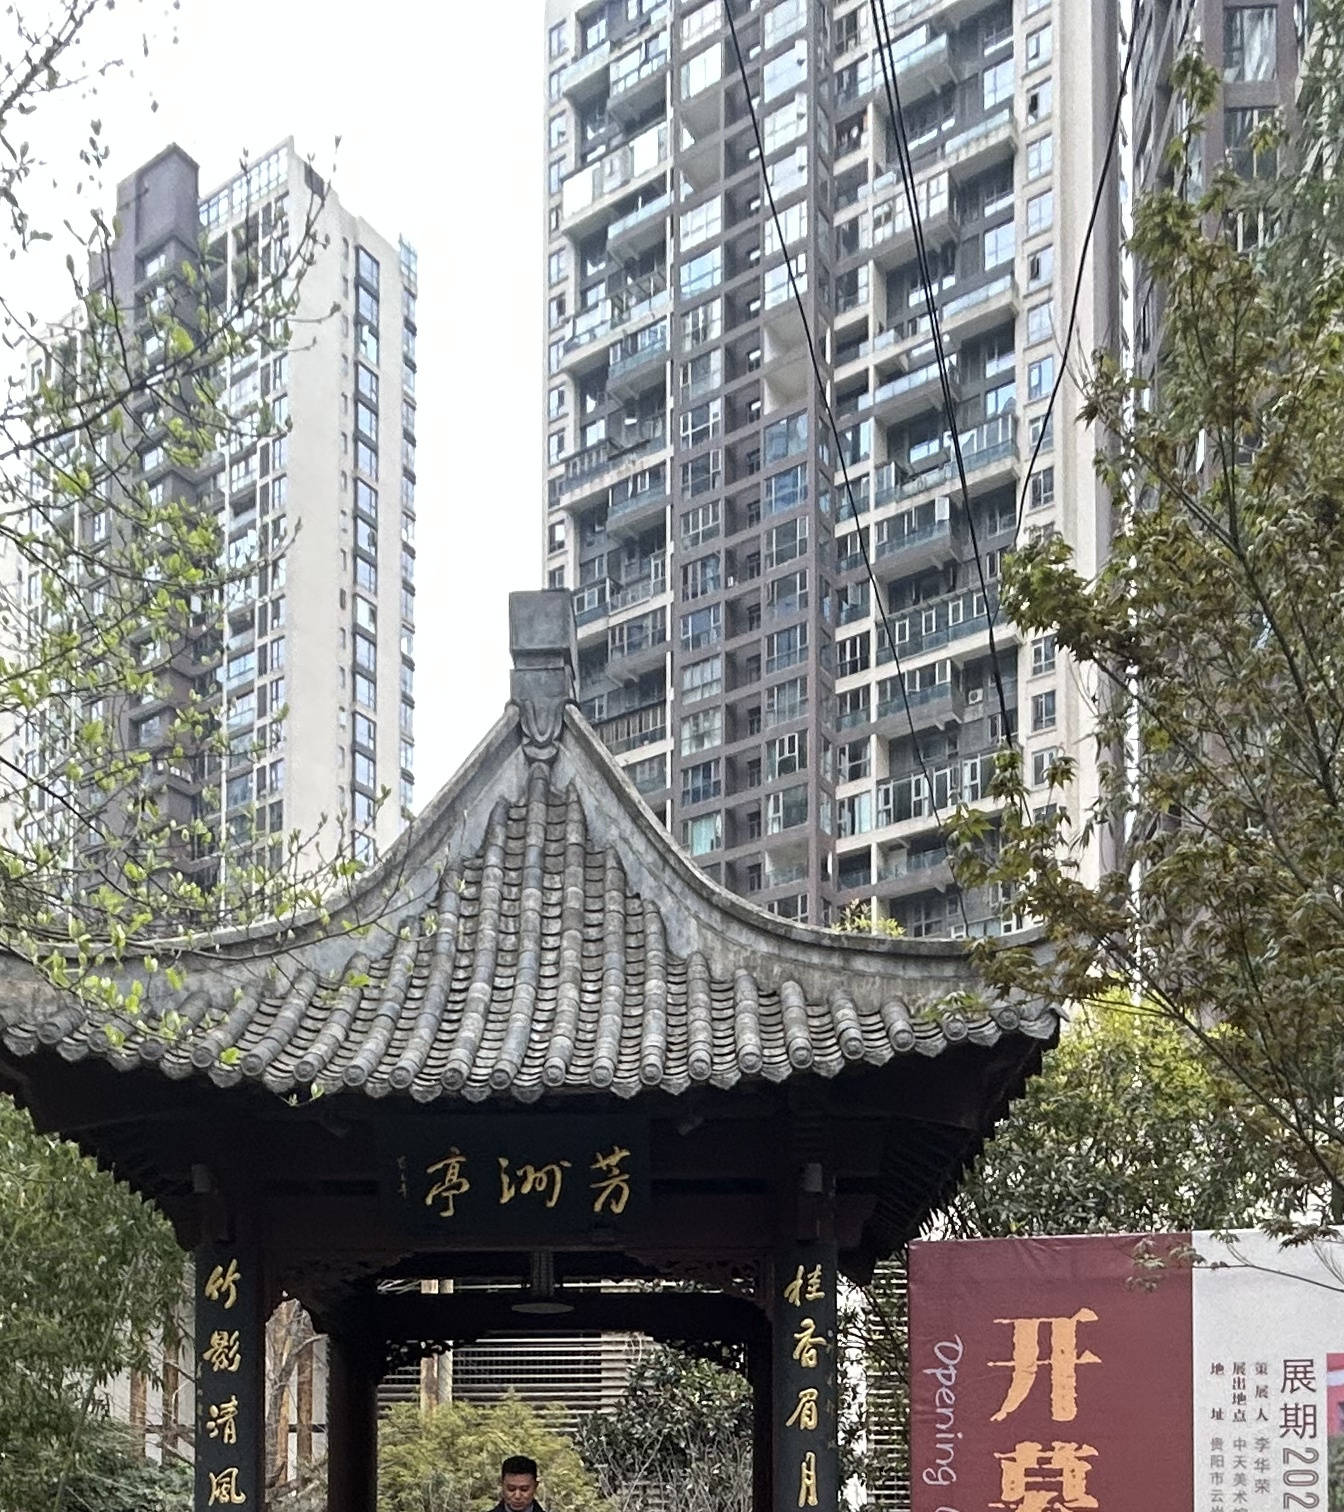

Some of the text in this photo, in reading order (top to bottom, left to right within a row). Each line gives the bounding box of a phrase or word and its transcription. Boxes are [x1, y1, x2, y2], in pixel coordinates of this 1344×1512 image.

[922, 1334, 964, 1486] Opening
[1232, 1361, 1248, 1423] 展出地点
[1253, 1362, 1271, 1494] 策展人 李华荣
